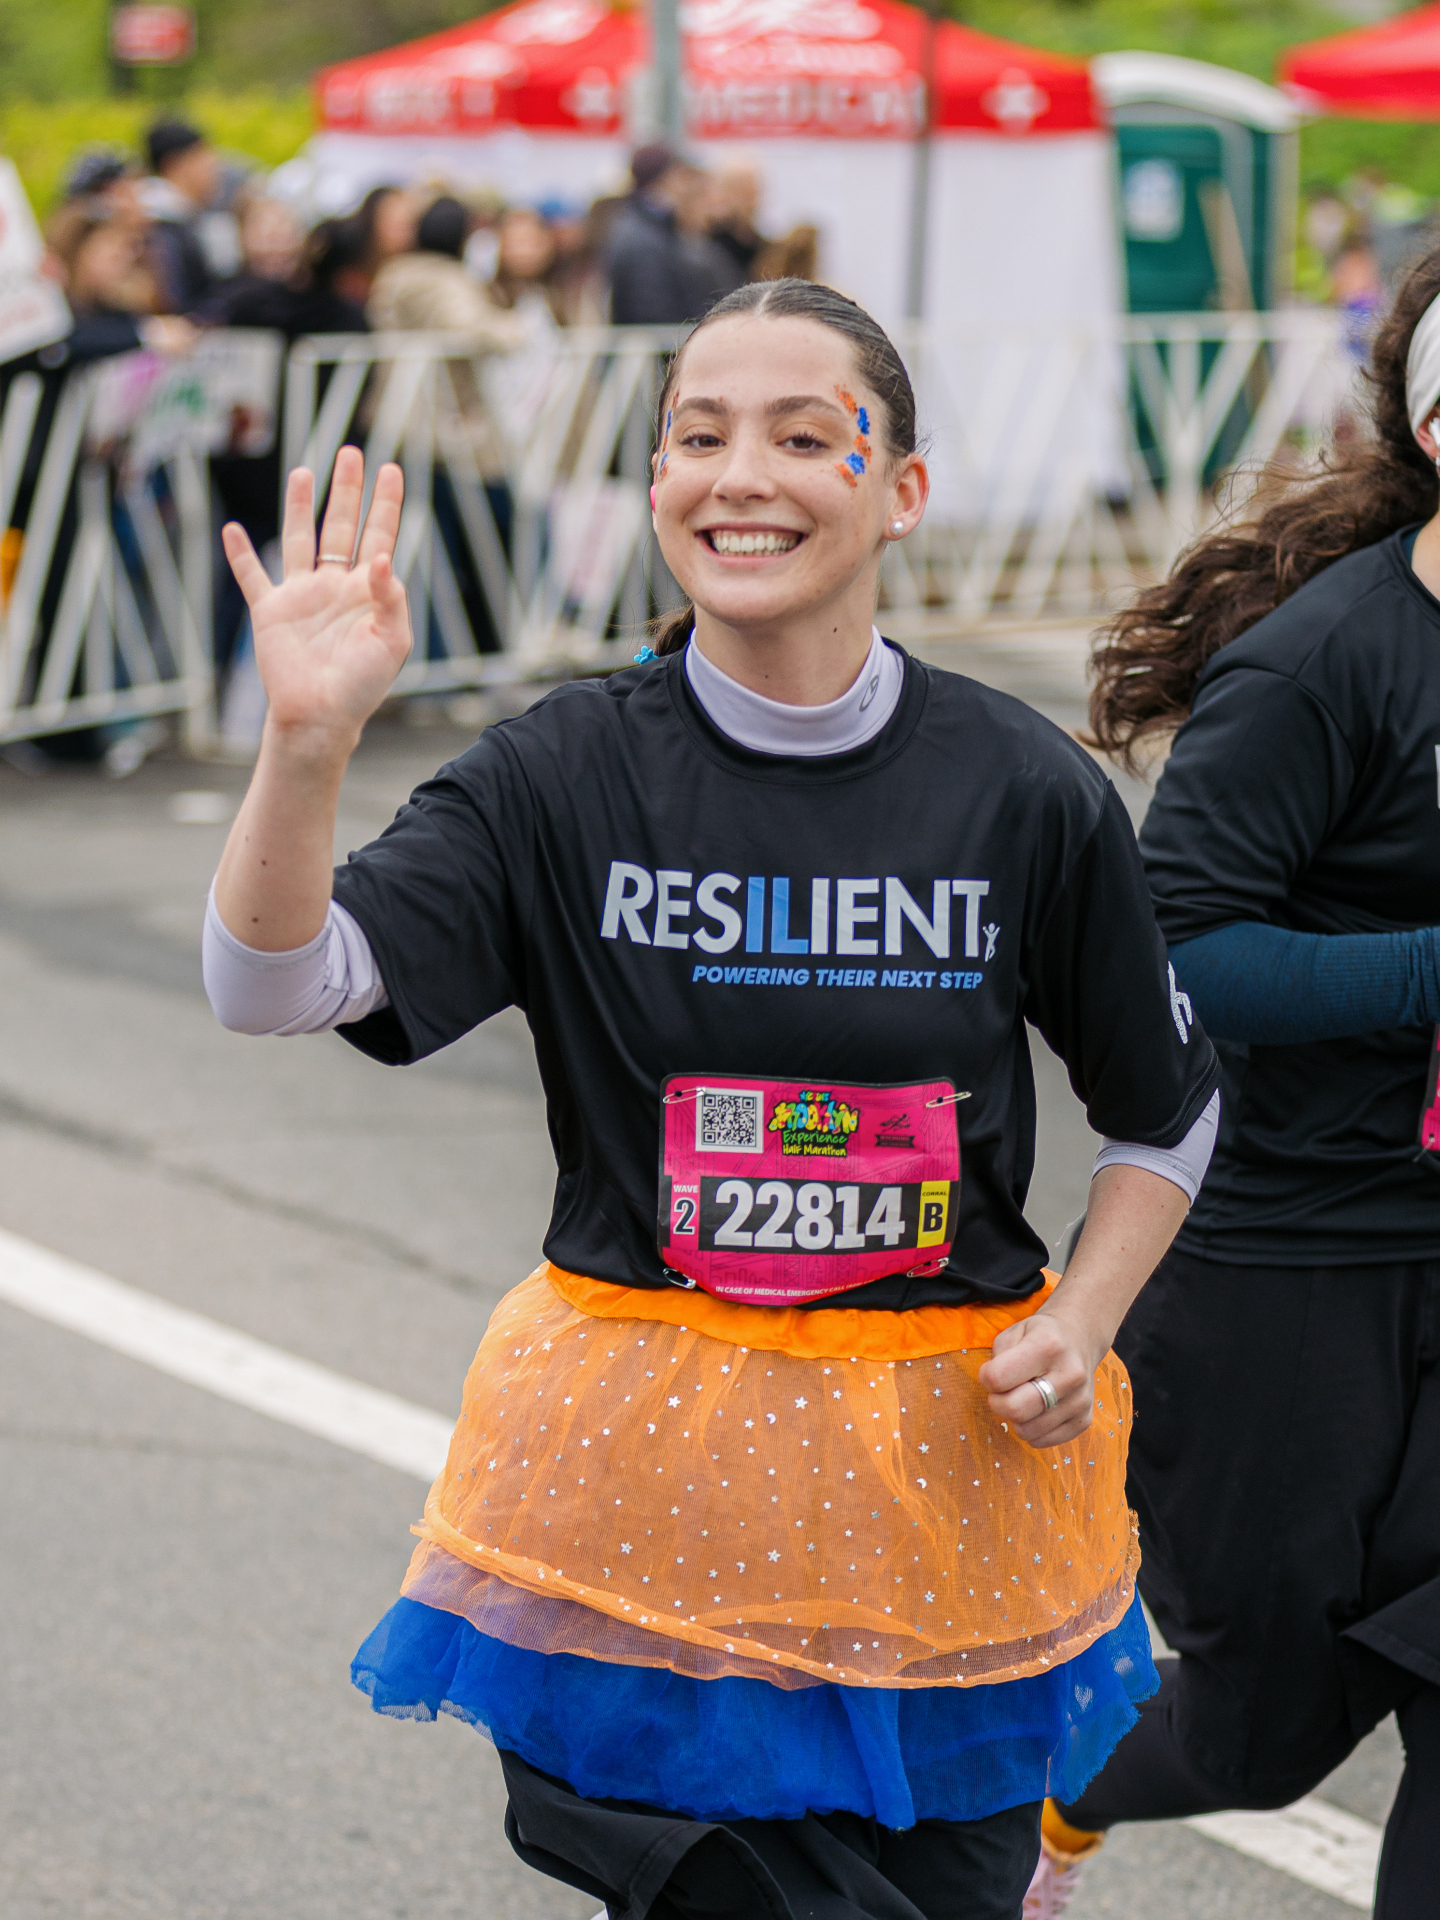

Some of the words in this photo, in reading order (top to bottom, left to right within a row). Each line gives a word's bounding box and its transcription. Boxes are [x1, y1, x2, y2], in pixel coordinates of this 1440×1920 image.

[600, 861, 990, 958] RESILIENT
[692, 965, 810, 986] POWERING
[815, 968, 877, 988] THEIR
[881, 970, 936, 989] NEXT
[939, 971, 983, 990] STEP
[782, 1129, 848, 1145] Experience
[803, 1143, 847, 1156] Marathon
[673, 1184, 699, 1194] WAVE
[672, 1196, 697, 1235] 2
[713, 1179, 906, 1250] 22814
[921, 1201, 944, 1233] B
[715, 1285, 724, 1293] IN
[724, 1286, 743, 1294] CASE
[743, 1287, 753, 1295] OF
[754, 1287, 786, 1297] MEDICAL
[786, 1287, 829, 1297] EMERGENCY
